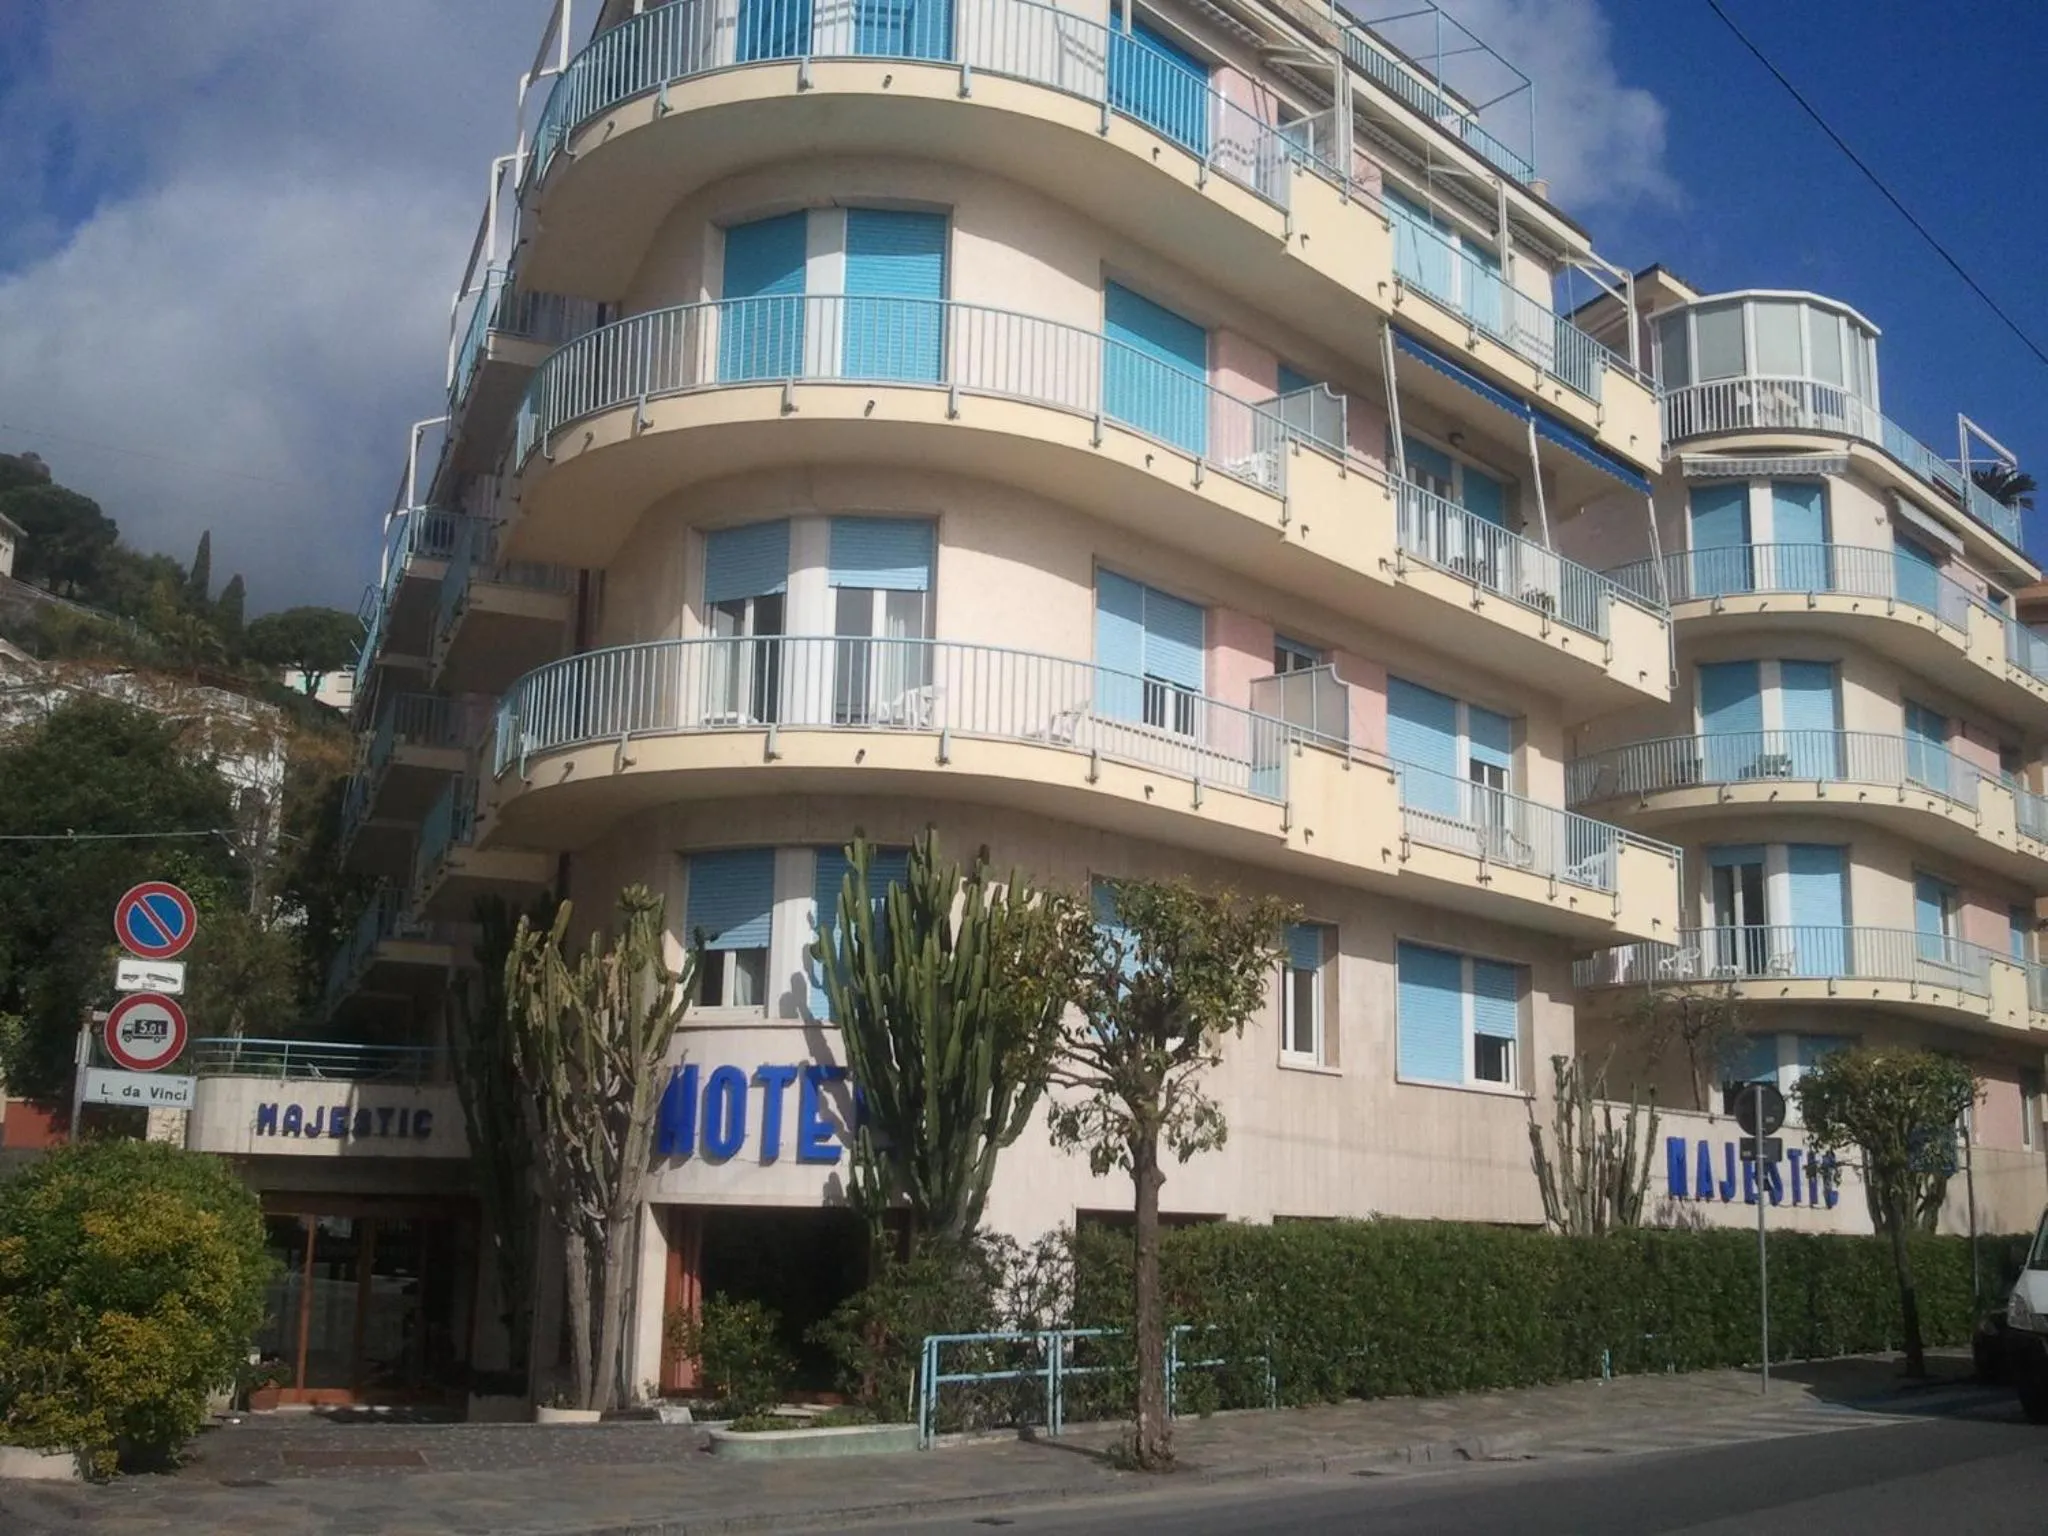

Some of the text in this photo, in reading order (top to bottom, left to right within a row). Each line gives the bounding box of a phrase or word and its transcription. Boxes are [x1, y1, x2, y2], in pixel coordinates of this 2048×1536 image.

[122, 1085, 141, 1098] da
[150, 1087, 188, 1101] Vinci
[256, 1102, 434, 1138] MAJESTIC
[655, 1064, 867, 1164] HOTE
